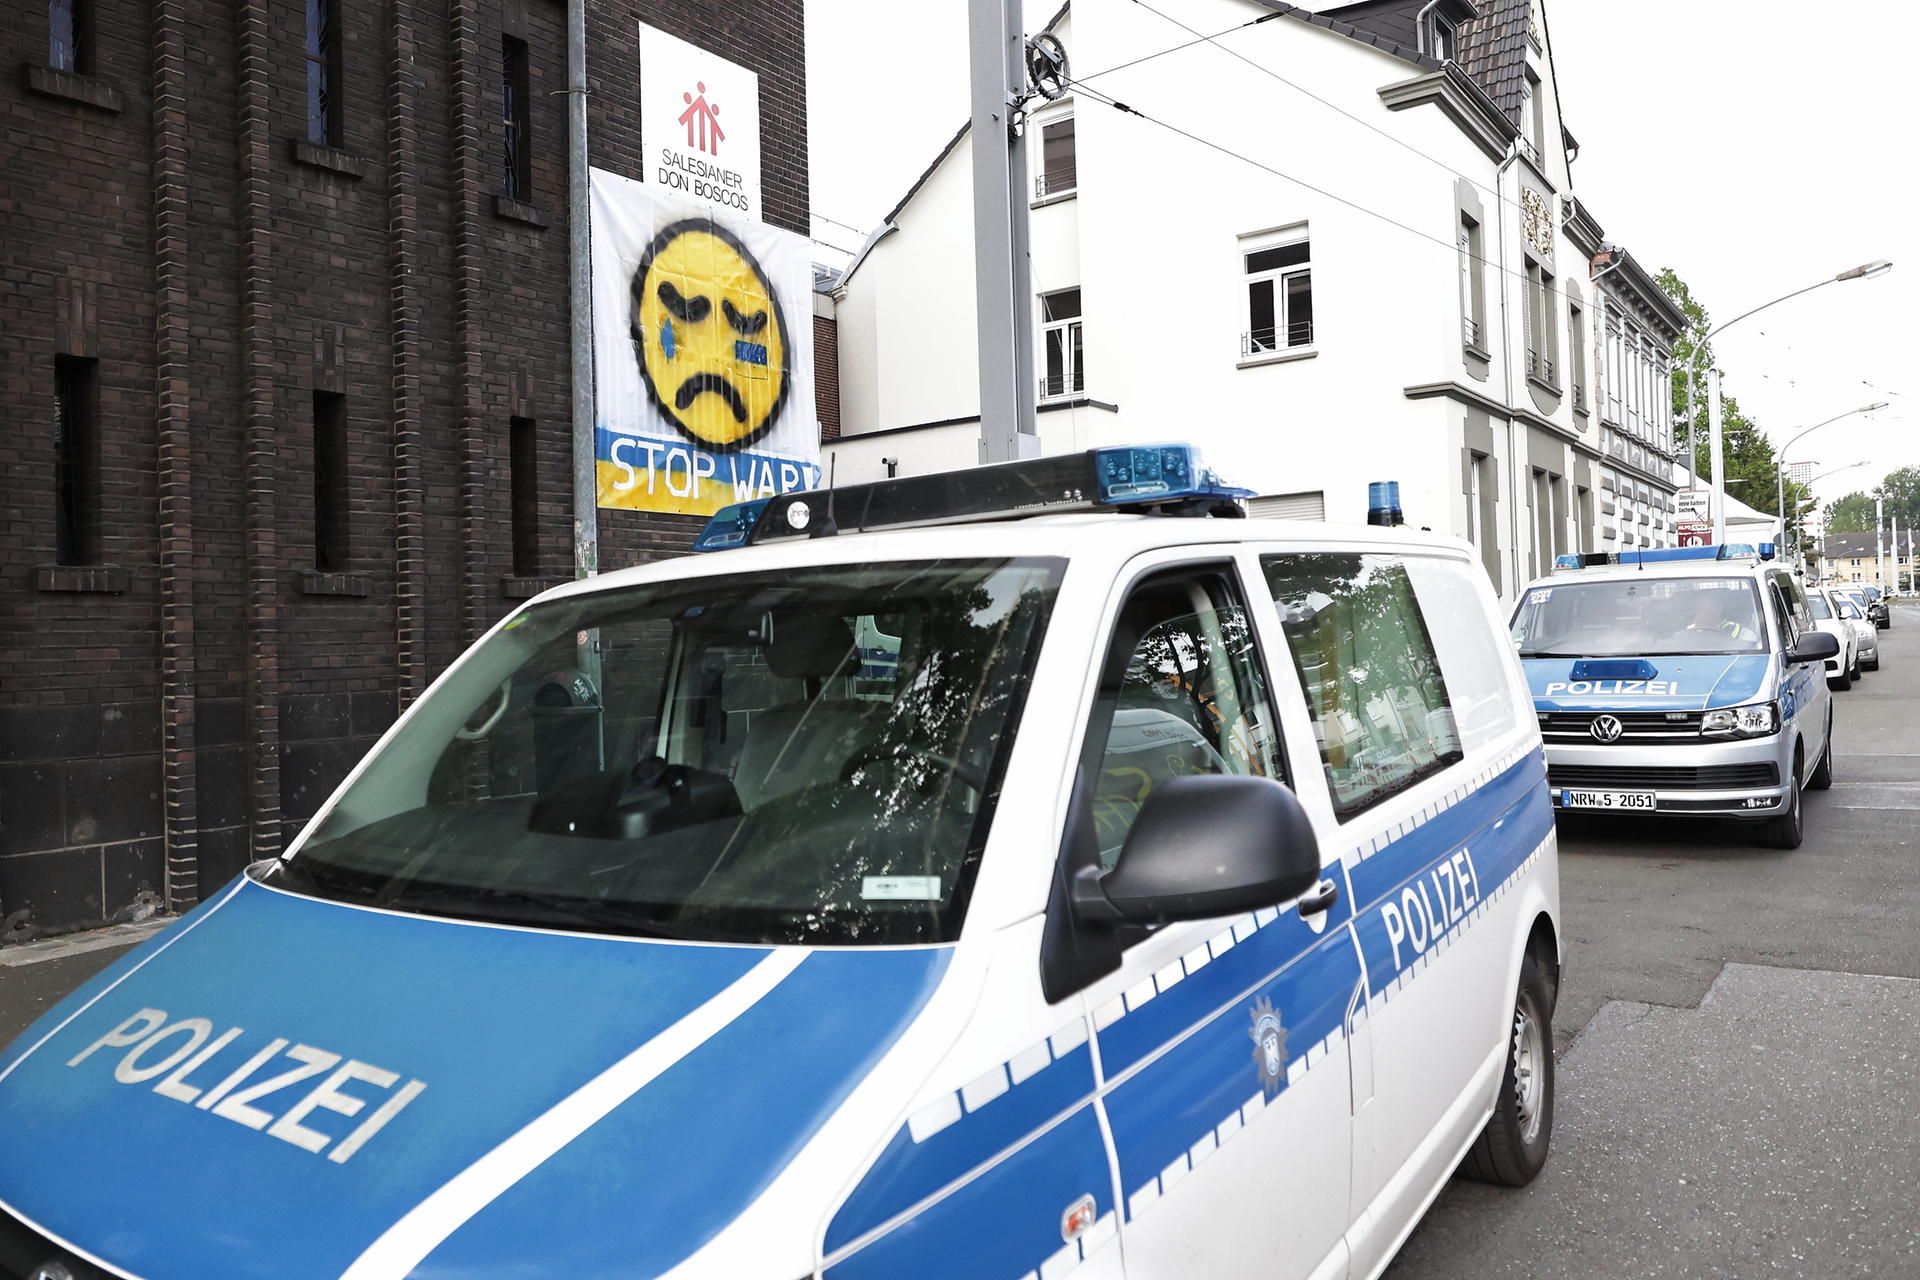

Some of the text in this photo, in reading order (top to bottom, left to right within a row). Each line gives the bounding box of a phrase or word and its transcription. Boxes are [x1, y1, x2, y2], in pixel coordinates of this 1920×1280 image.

[658, 167, 749, 211] DON BOSCOS
[662, 148, 743, 191] SALESIANER
[610, 438, 716, 500] STOP
[1545, 680, 1678, 696] POLIZEI
[1570, 793, 1596, 806] NRW
[1380, 847, 1480, 971] POLIZEI
[66, 1008, 428, 1165] POLIZEI
